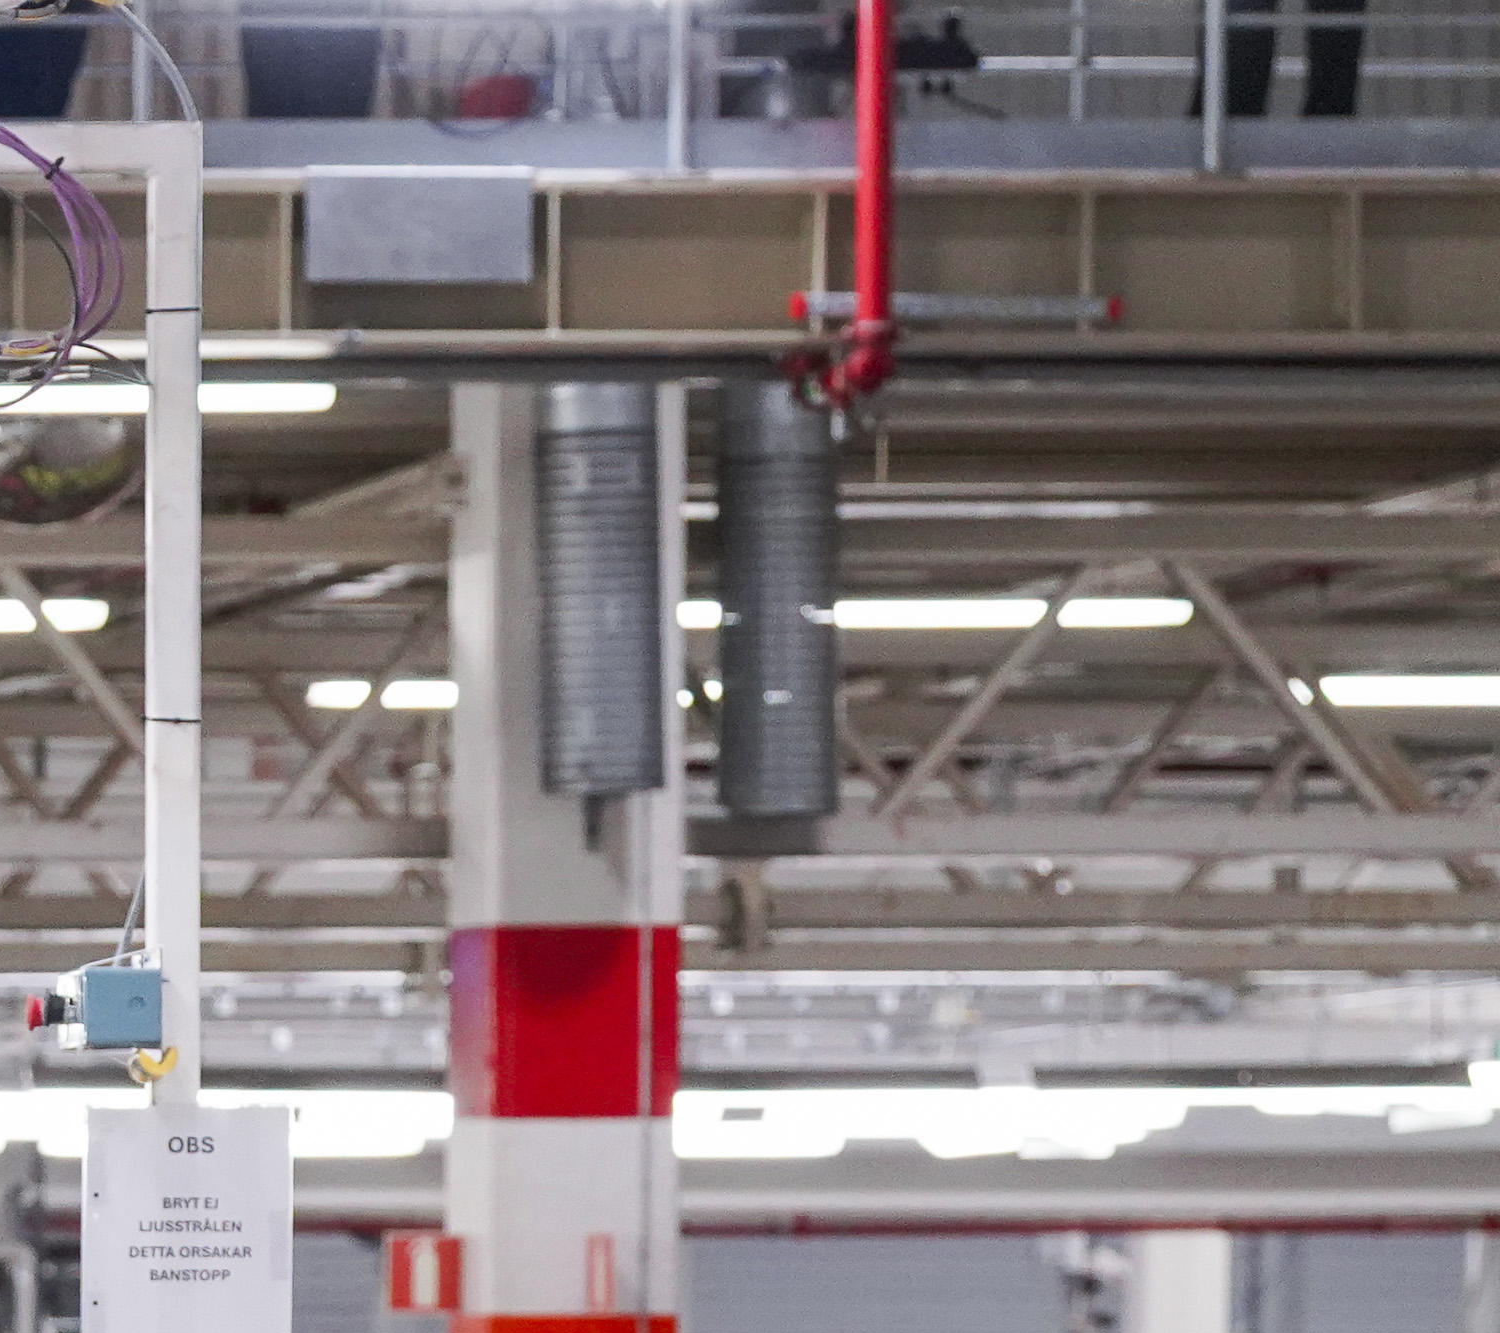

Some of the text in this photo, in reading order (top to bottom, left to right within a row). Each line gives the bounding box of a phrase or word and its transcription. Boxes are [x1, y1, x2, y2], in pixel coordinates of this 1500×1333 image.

[167, 1136, 216, 1153] OBS
[162, 1197, 219, 1209] BRYT EJ
[138, 1217, 243, 1232] LJUSSTRÅLEN
[128, 1246, 253, 1258] DETTA ORSAKAR
[149, 1269, 232, 1281] BANSTOPP
